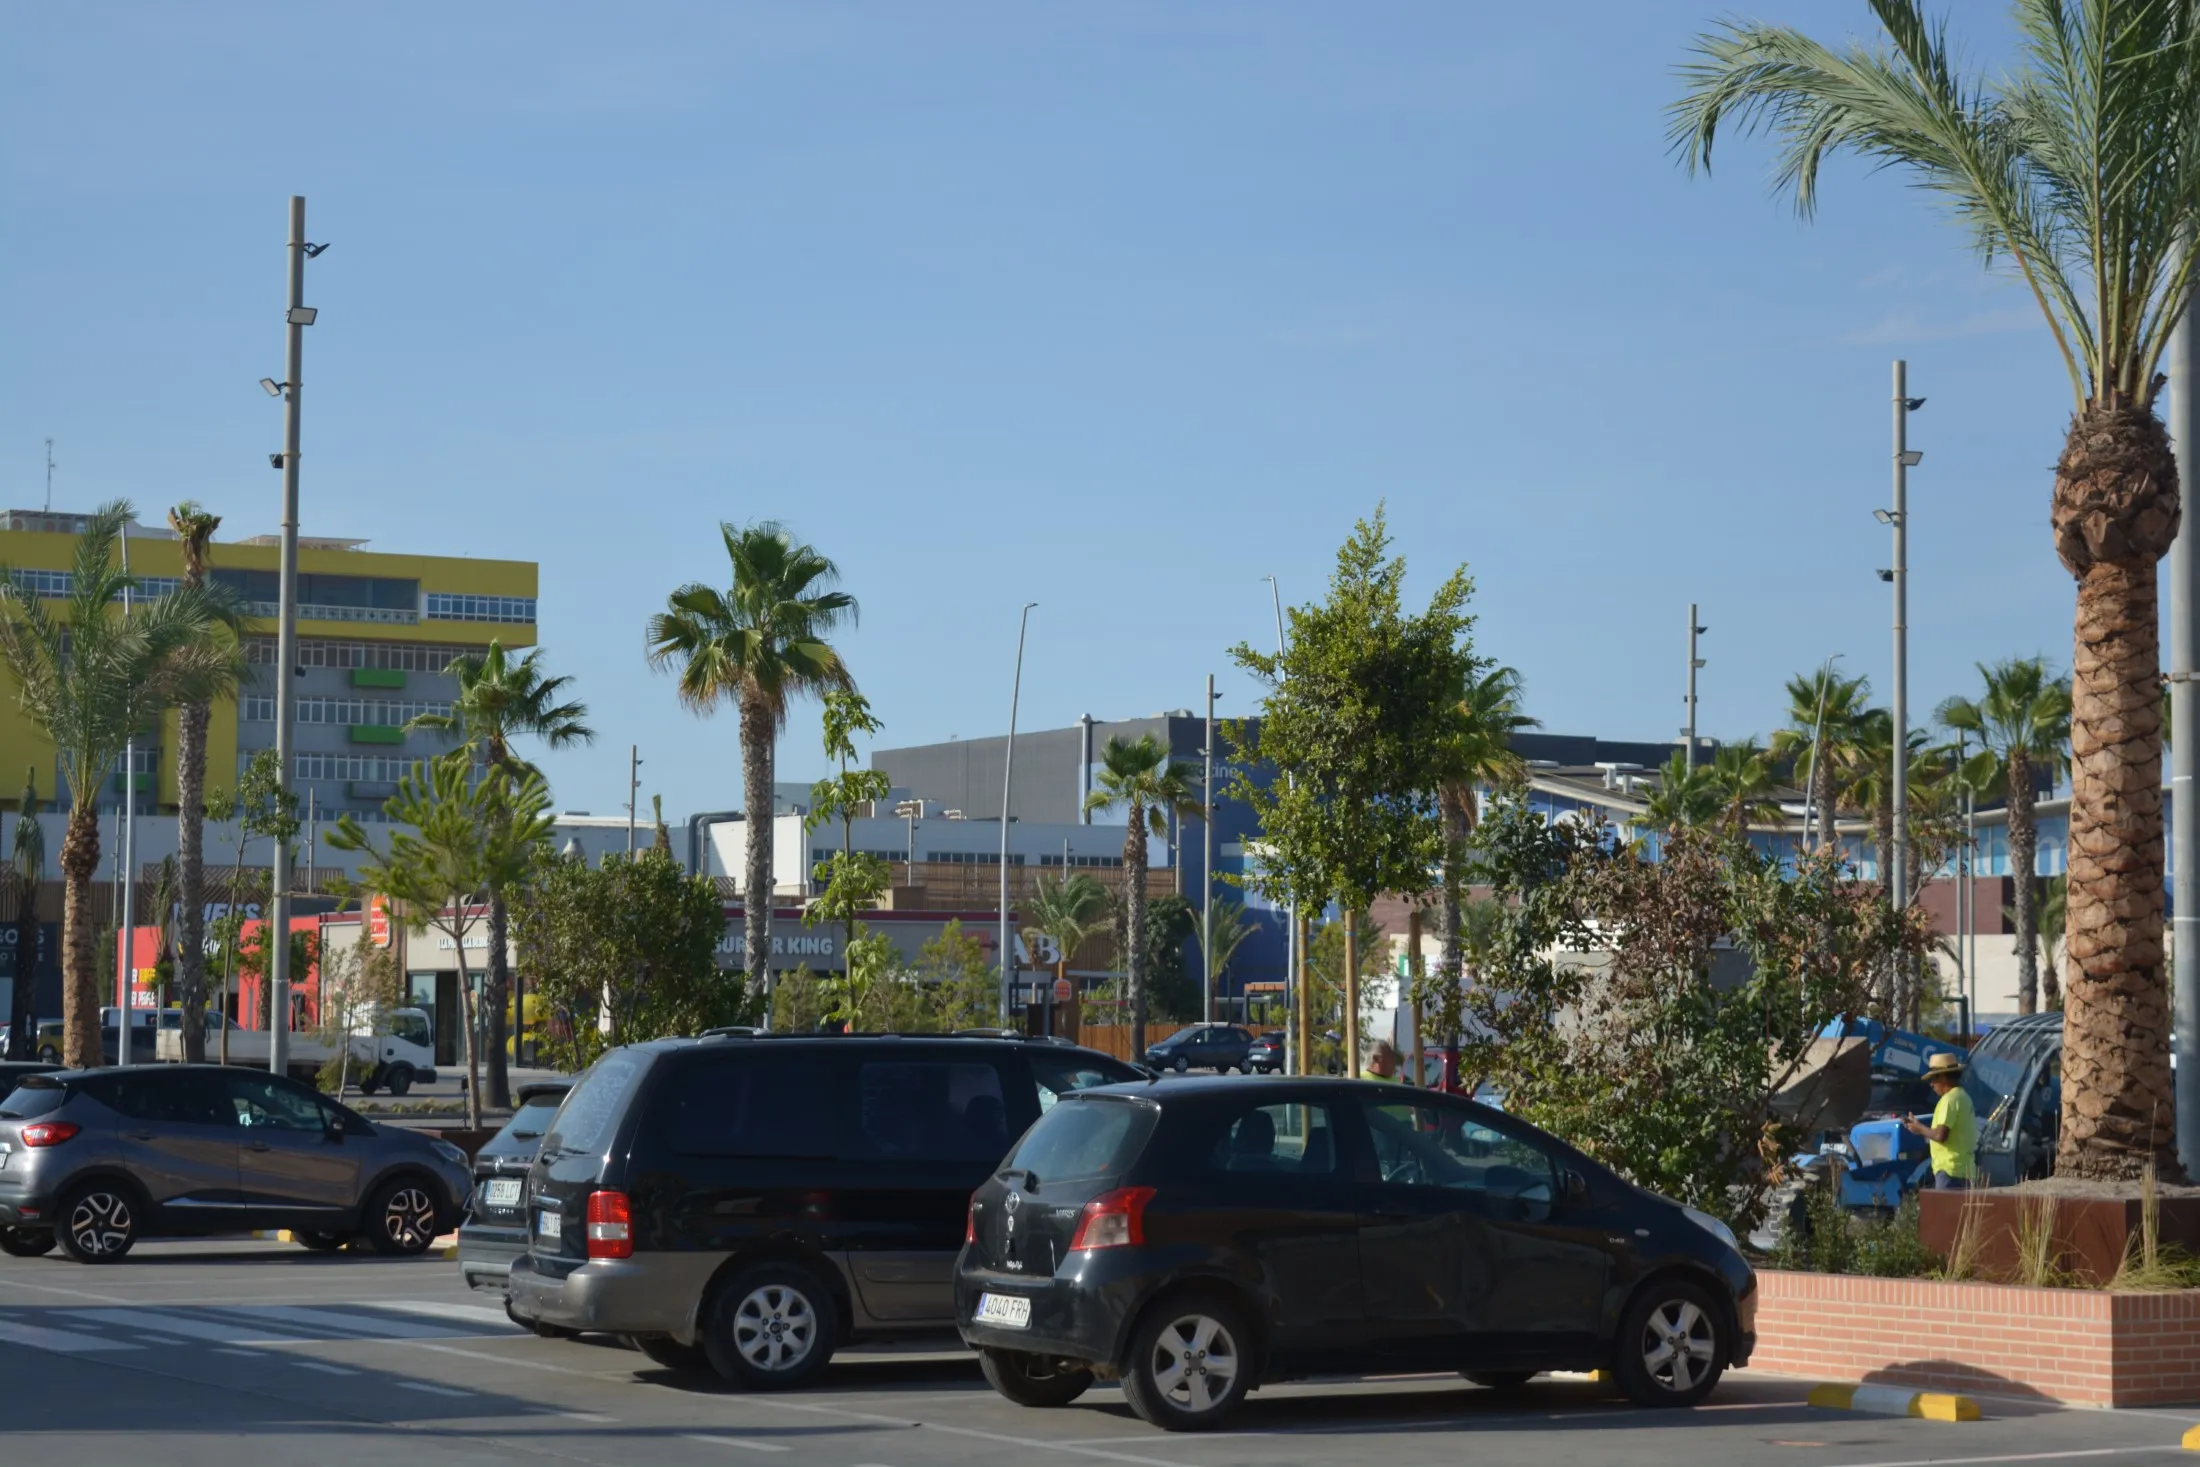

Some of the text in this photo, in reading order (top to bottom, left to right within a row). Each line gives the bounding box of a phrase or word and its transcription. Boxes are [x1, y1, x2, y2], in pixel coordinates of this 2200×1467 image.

[787, 937, 834, 955] KING
[985, 1295, 1030, 1319] 4040 FRH
